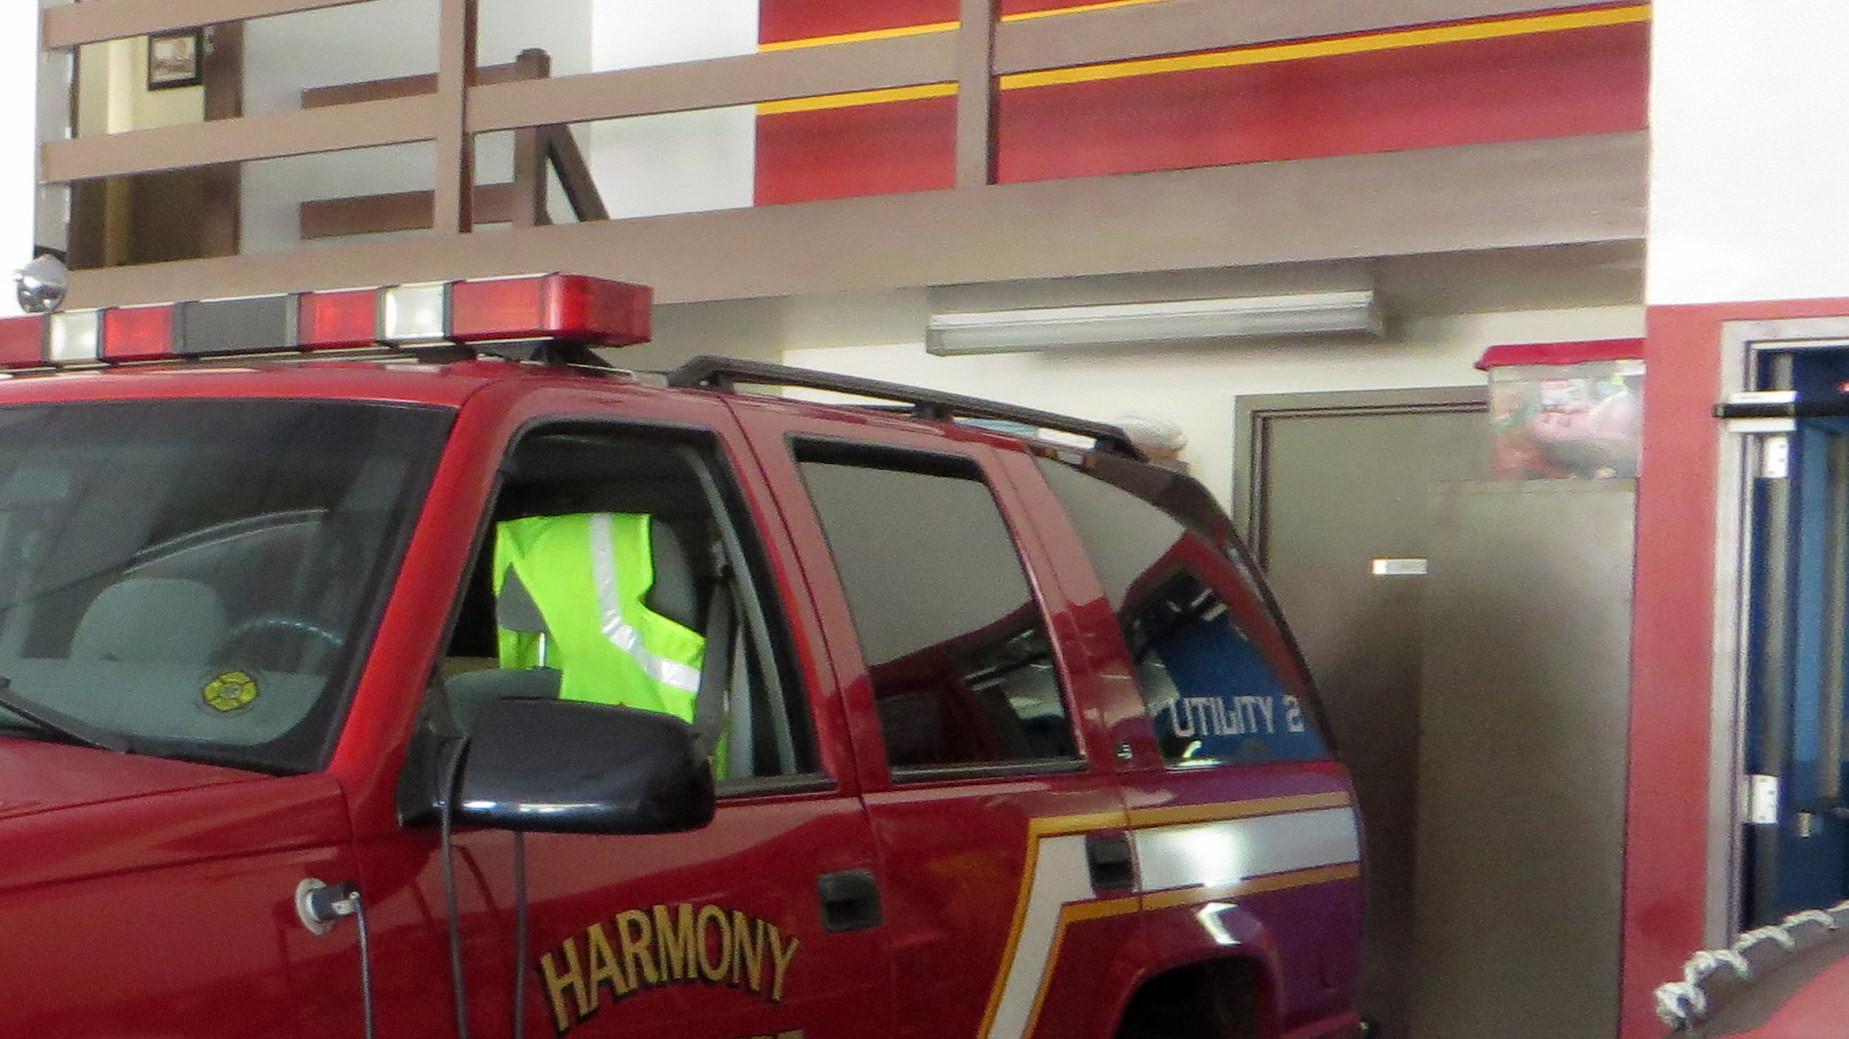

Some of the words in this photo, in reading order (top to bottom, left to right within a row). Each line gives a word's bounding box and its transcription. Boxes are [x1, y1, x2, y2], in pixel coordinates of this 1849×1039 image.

[1170, 695, 1275, 738] UTILITY
[1282, 694, 1306, 734] 2
[538, 902, 800, 1035] HARMONY
